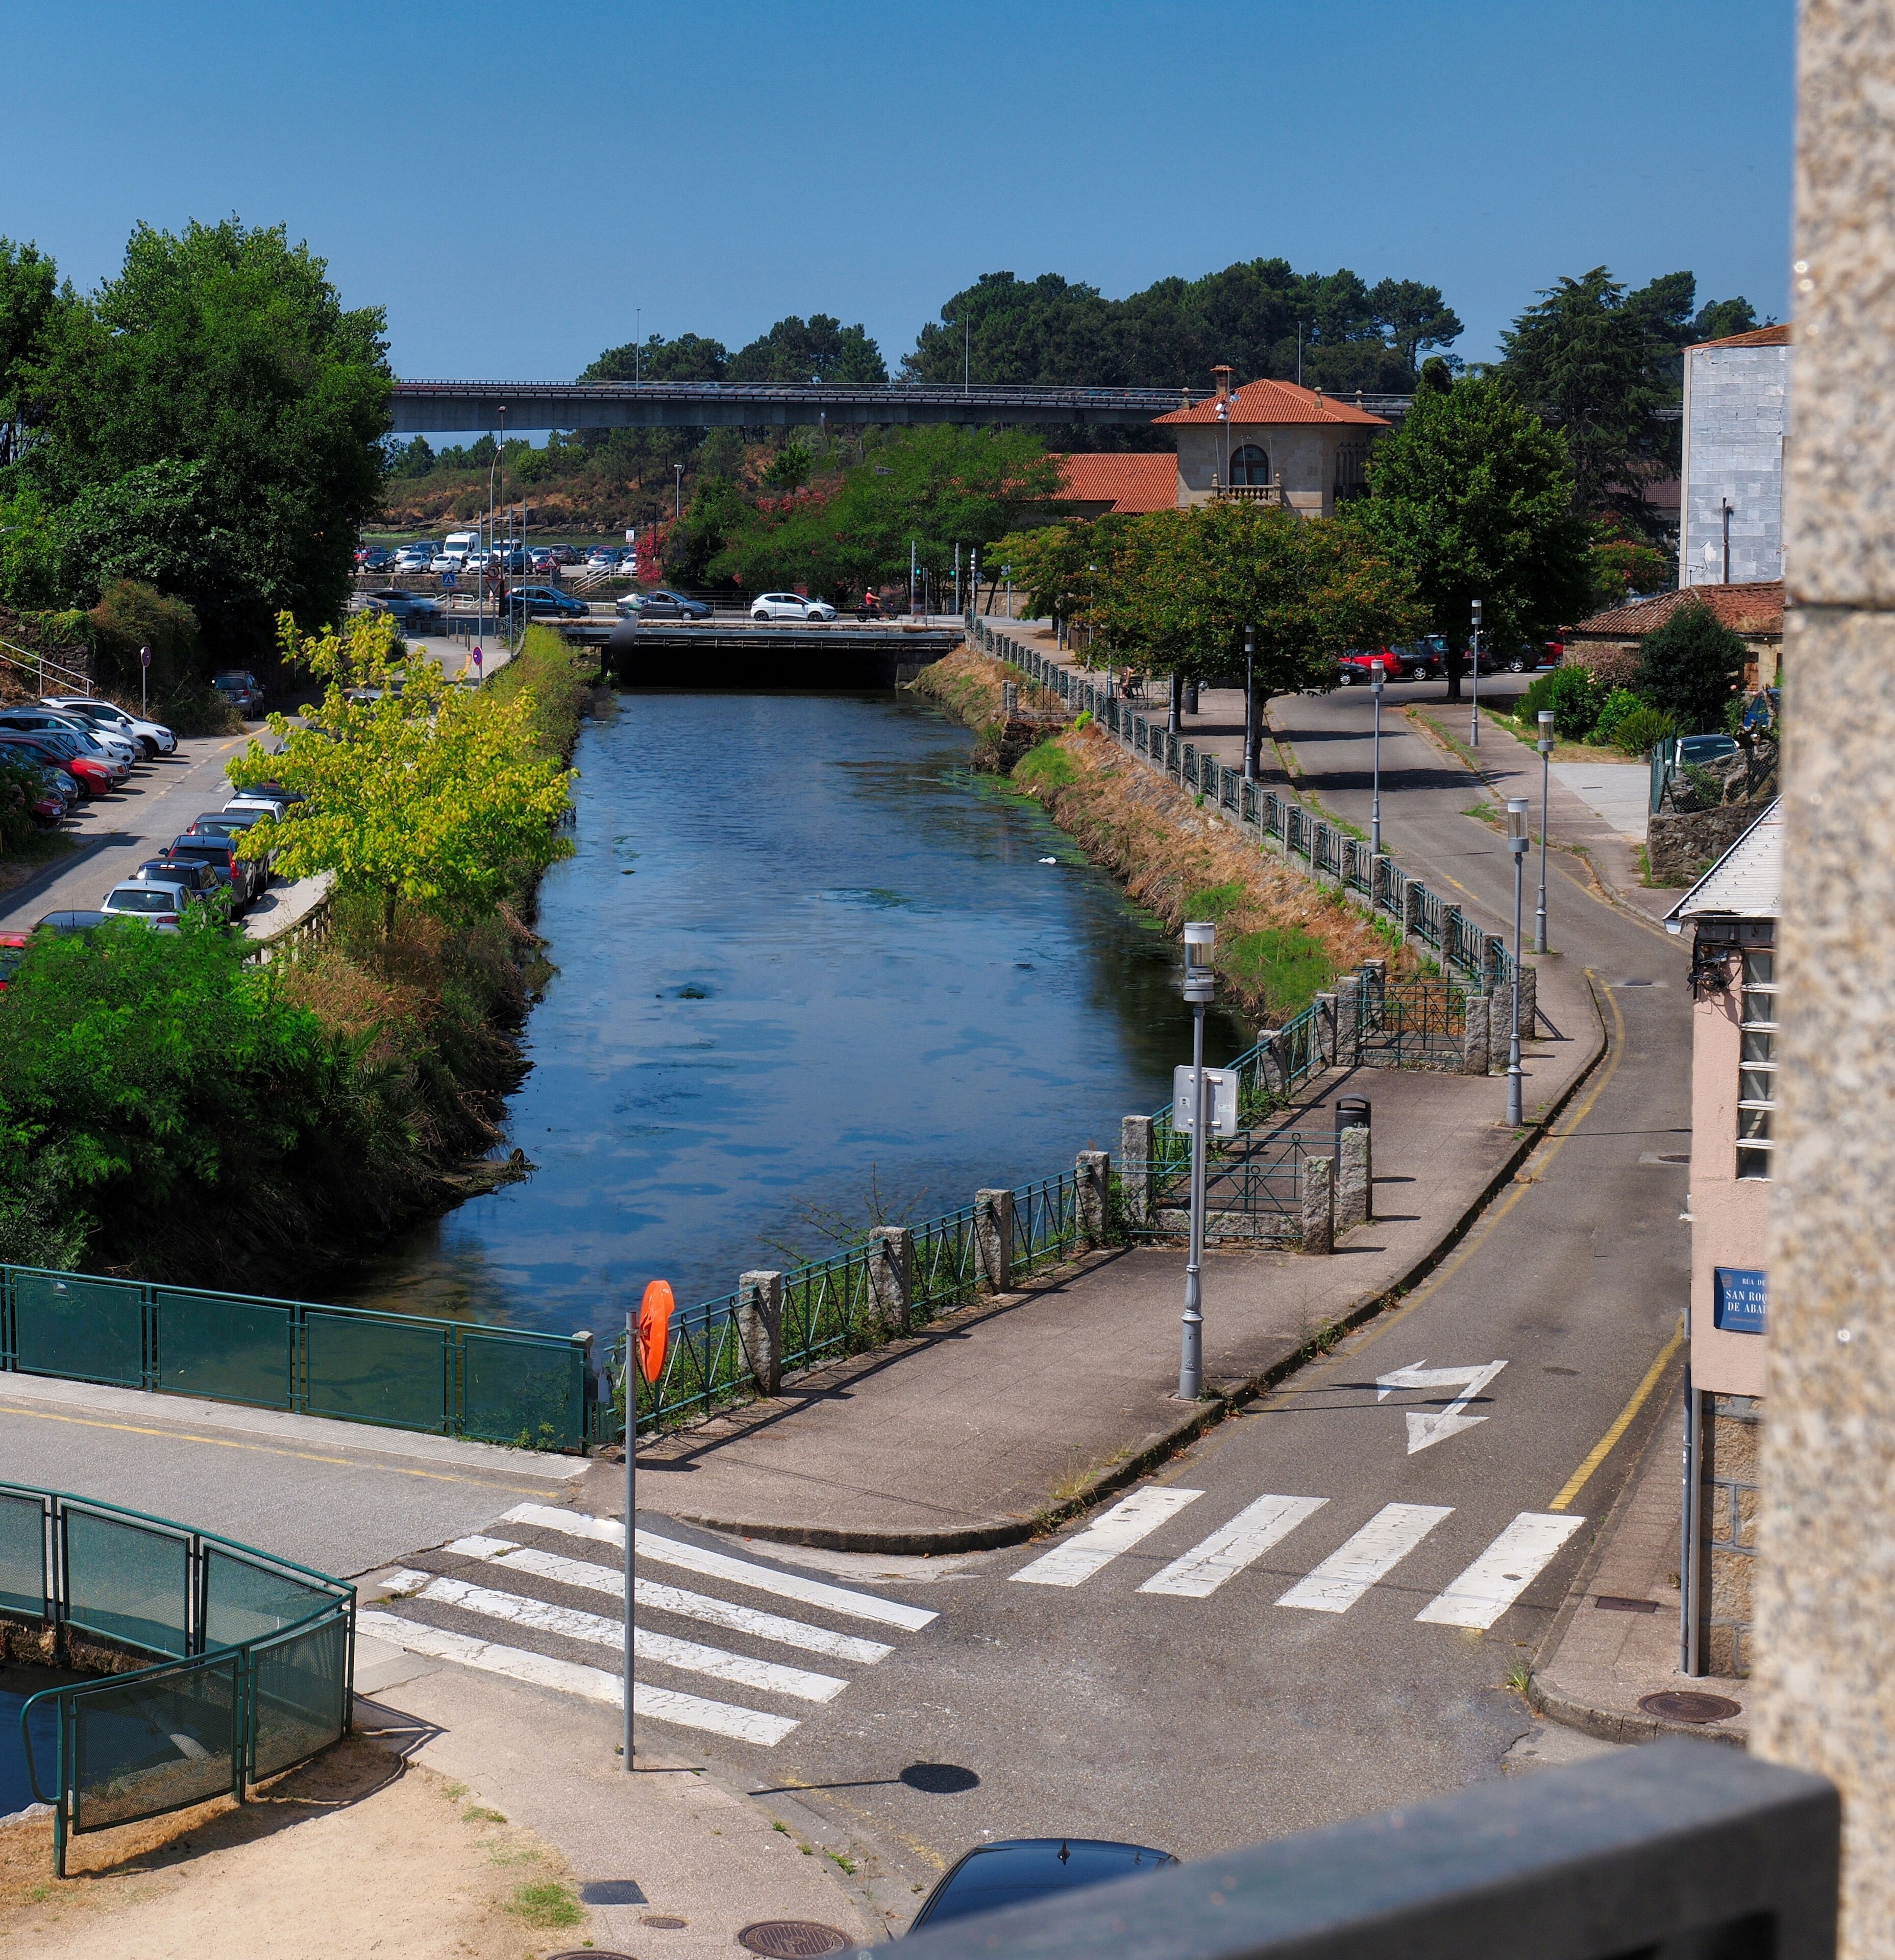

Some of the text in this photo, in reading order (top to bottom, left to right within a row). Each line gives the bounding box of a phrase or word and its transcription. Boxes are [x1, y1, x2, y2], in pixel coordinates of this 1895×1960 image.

[1726, 1290, 1767, 1304] SAN ROQ
[1728, 1302, 1766, 1314] DE ABAI
